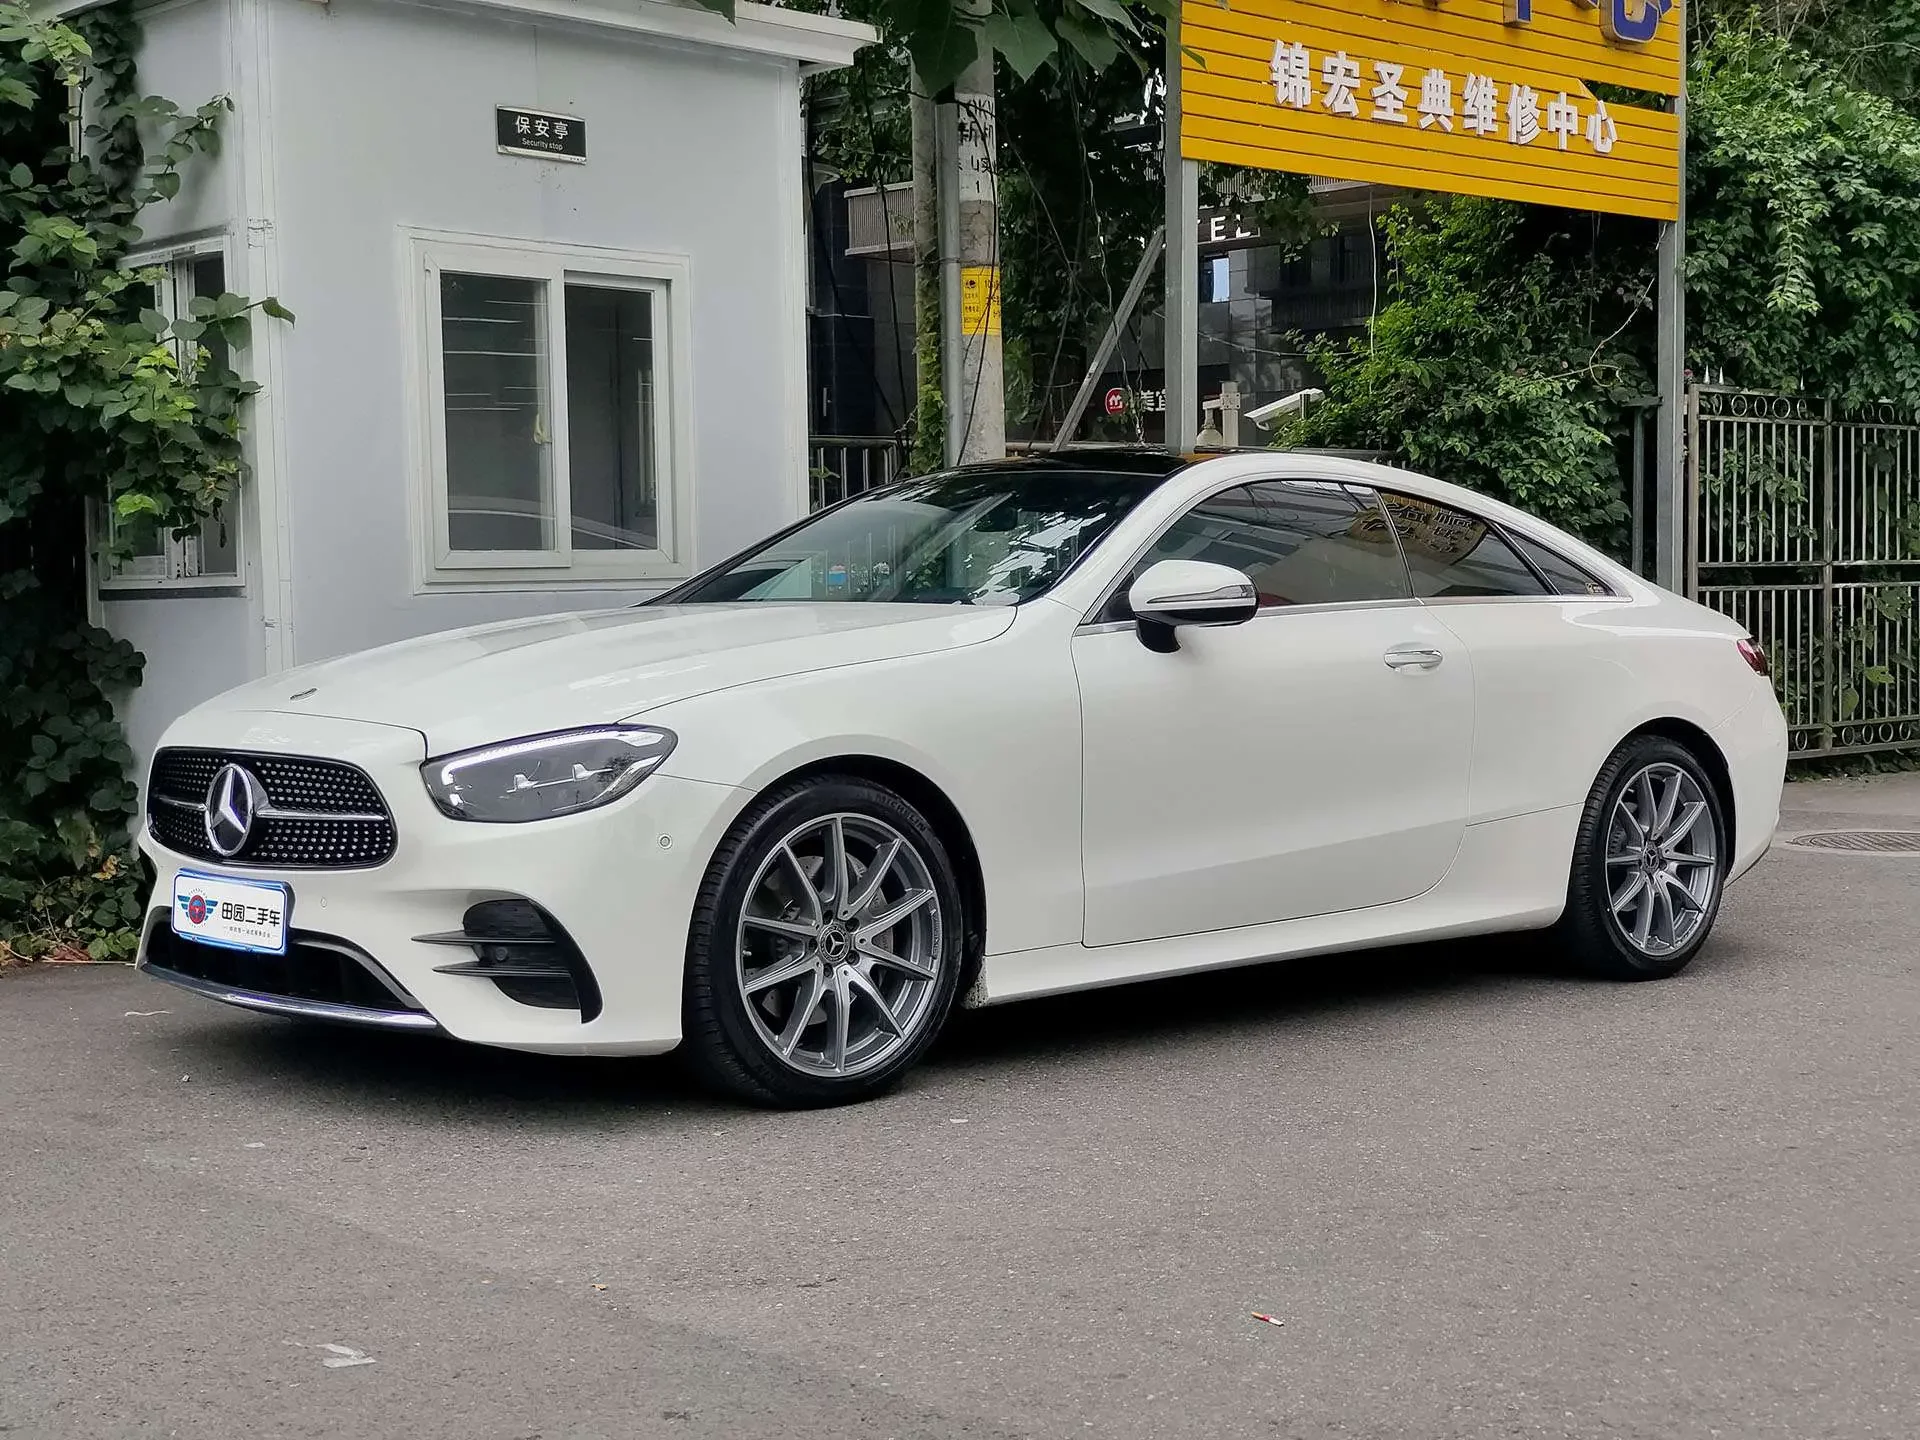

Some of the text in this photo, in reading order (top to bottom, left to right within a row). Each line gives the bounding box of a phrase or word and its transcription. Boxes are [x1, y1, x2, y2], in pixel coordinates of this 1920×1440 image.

[1269, 39, 1618, 153] 锦宏圣典维修中心
[515, 115, 569, 139] 保安亭
[521, 137, 563, 151] Security stop
[1197, 214, 1251, 242] EL
[221, 901, 281, 927] 田园二手车
